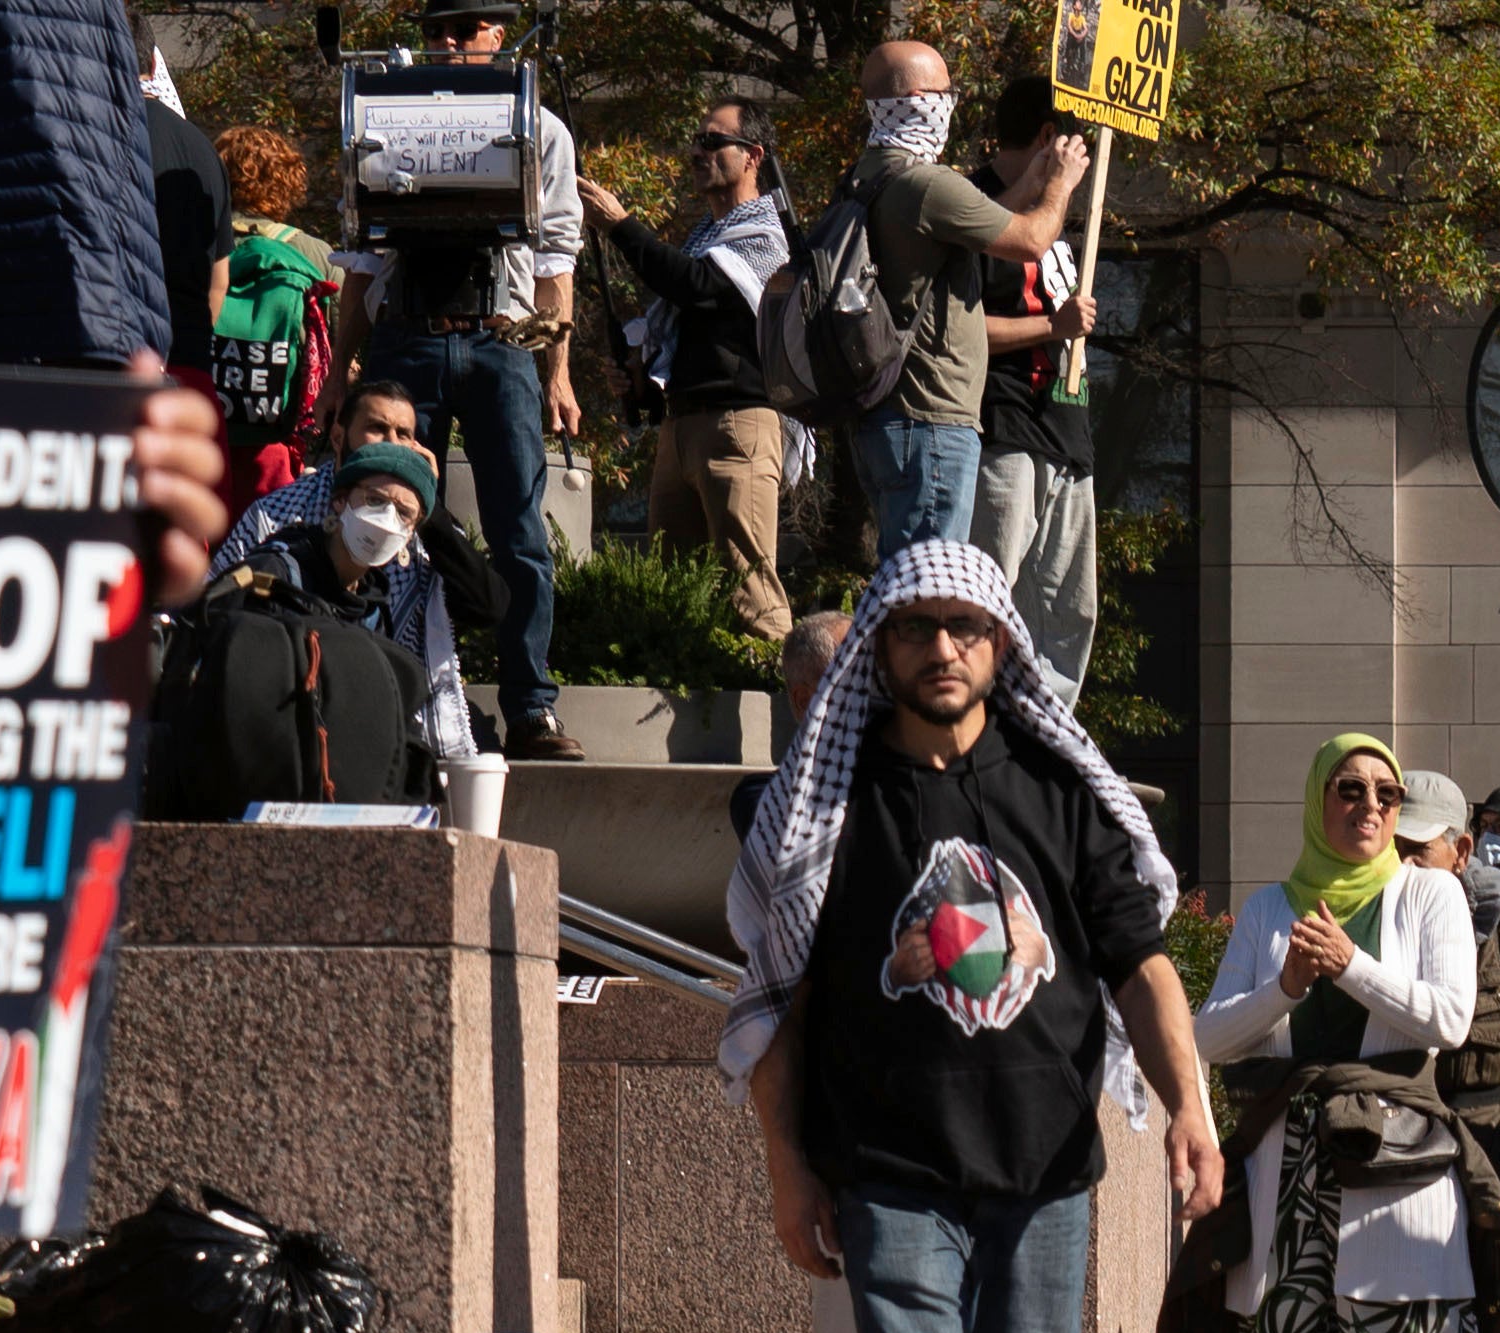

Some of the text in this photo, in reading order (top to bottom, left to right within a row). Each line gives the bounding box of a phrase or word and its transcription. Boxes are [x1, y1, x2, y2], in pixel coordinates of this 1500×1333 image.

[1136, 17, 1172, 69] ON
[1105, 56, 1163, 117] GAZA
[415, 131, 436, 146] will
[442, 130, 466, 146] NOT
[471, 131, 488, 143] be
[1054, 89, 1160, 142] ANSWERCOALITION.ORG
[210, 335, 288, 364] ASE
[212, 363, 269, 392] IRE
[95, 433, 141, 512] T
[28, 700, 131, 780] THE
